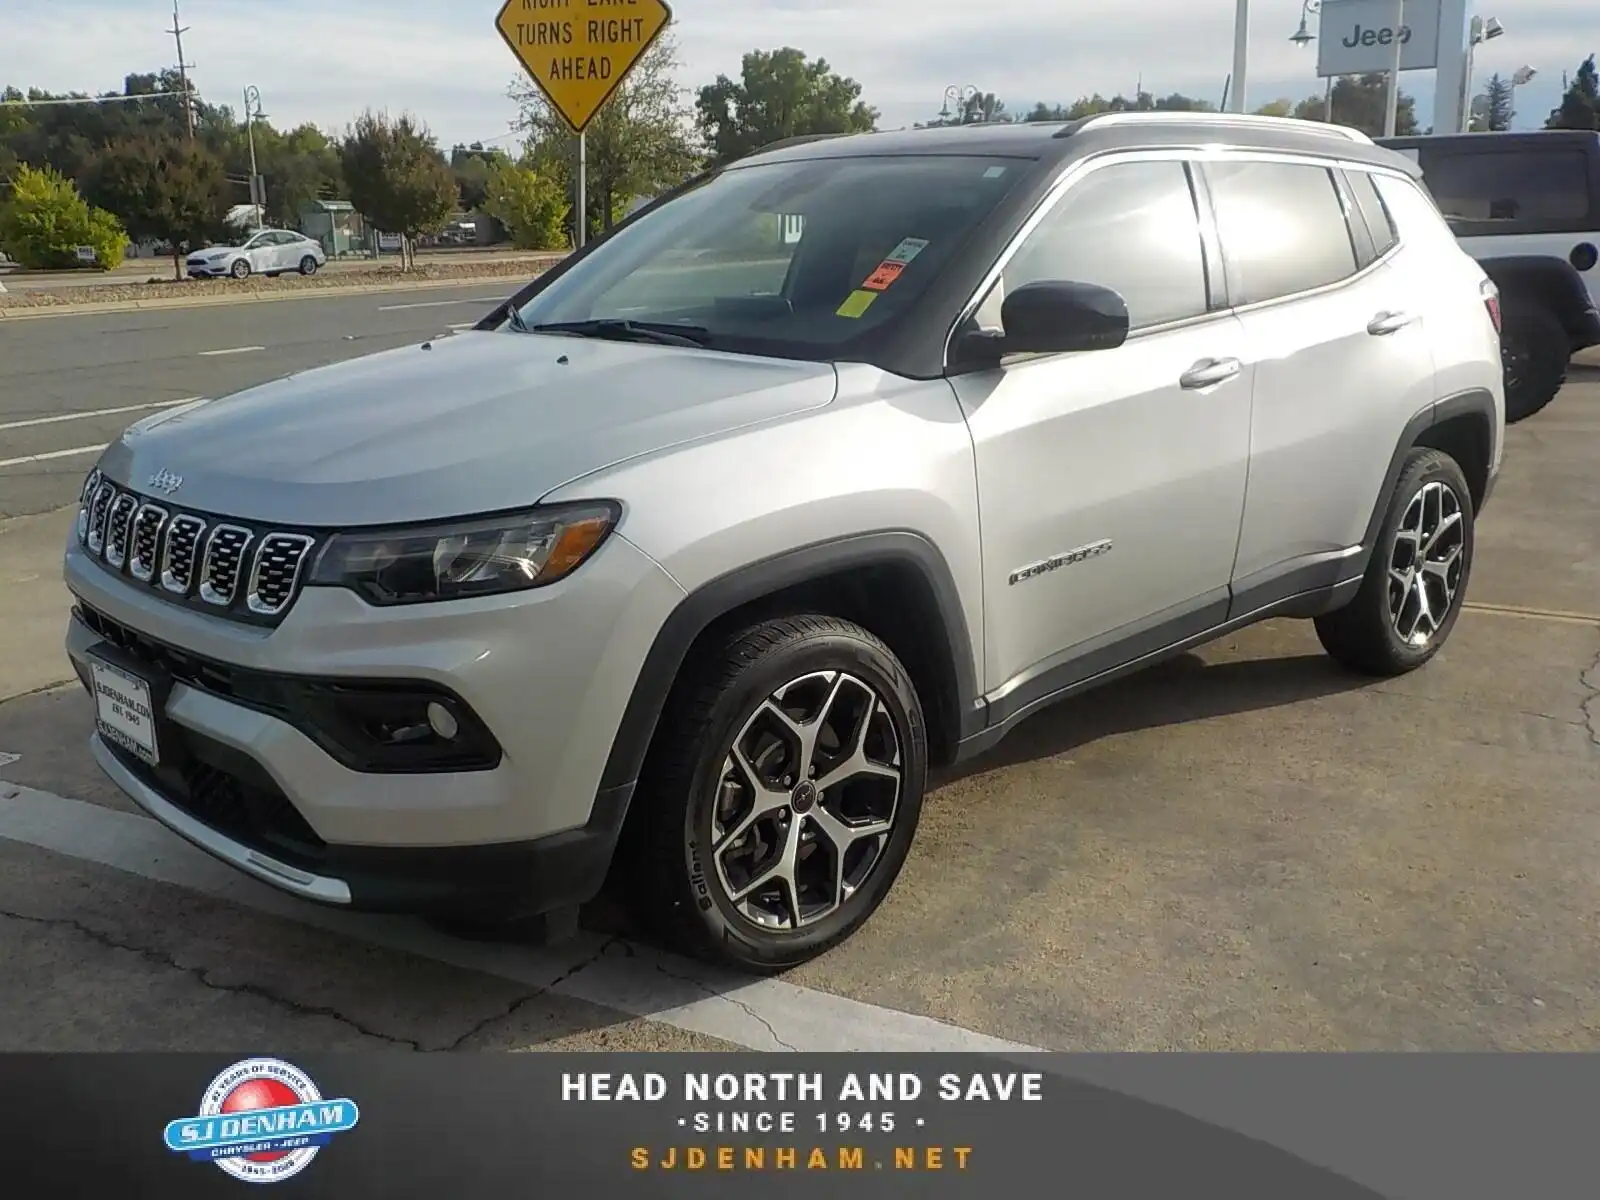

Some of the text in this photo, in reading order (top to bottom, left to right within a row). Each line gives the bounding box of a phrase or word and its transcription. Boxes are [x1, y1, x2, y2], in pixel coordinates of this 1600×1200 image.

[516, 18, 644, 45] TURNS RIGHT
[1342, 24, 1412, 48] Jeep
[549, 56, 612, 80] AHEAD
